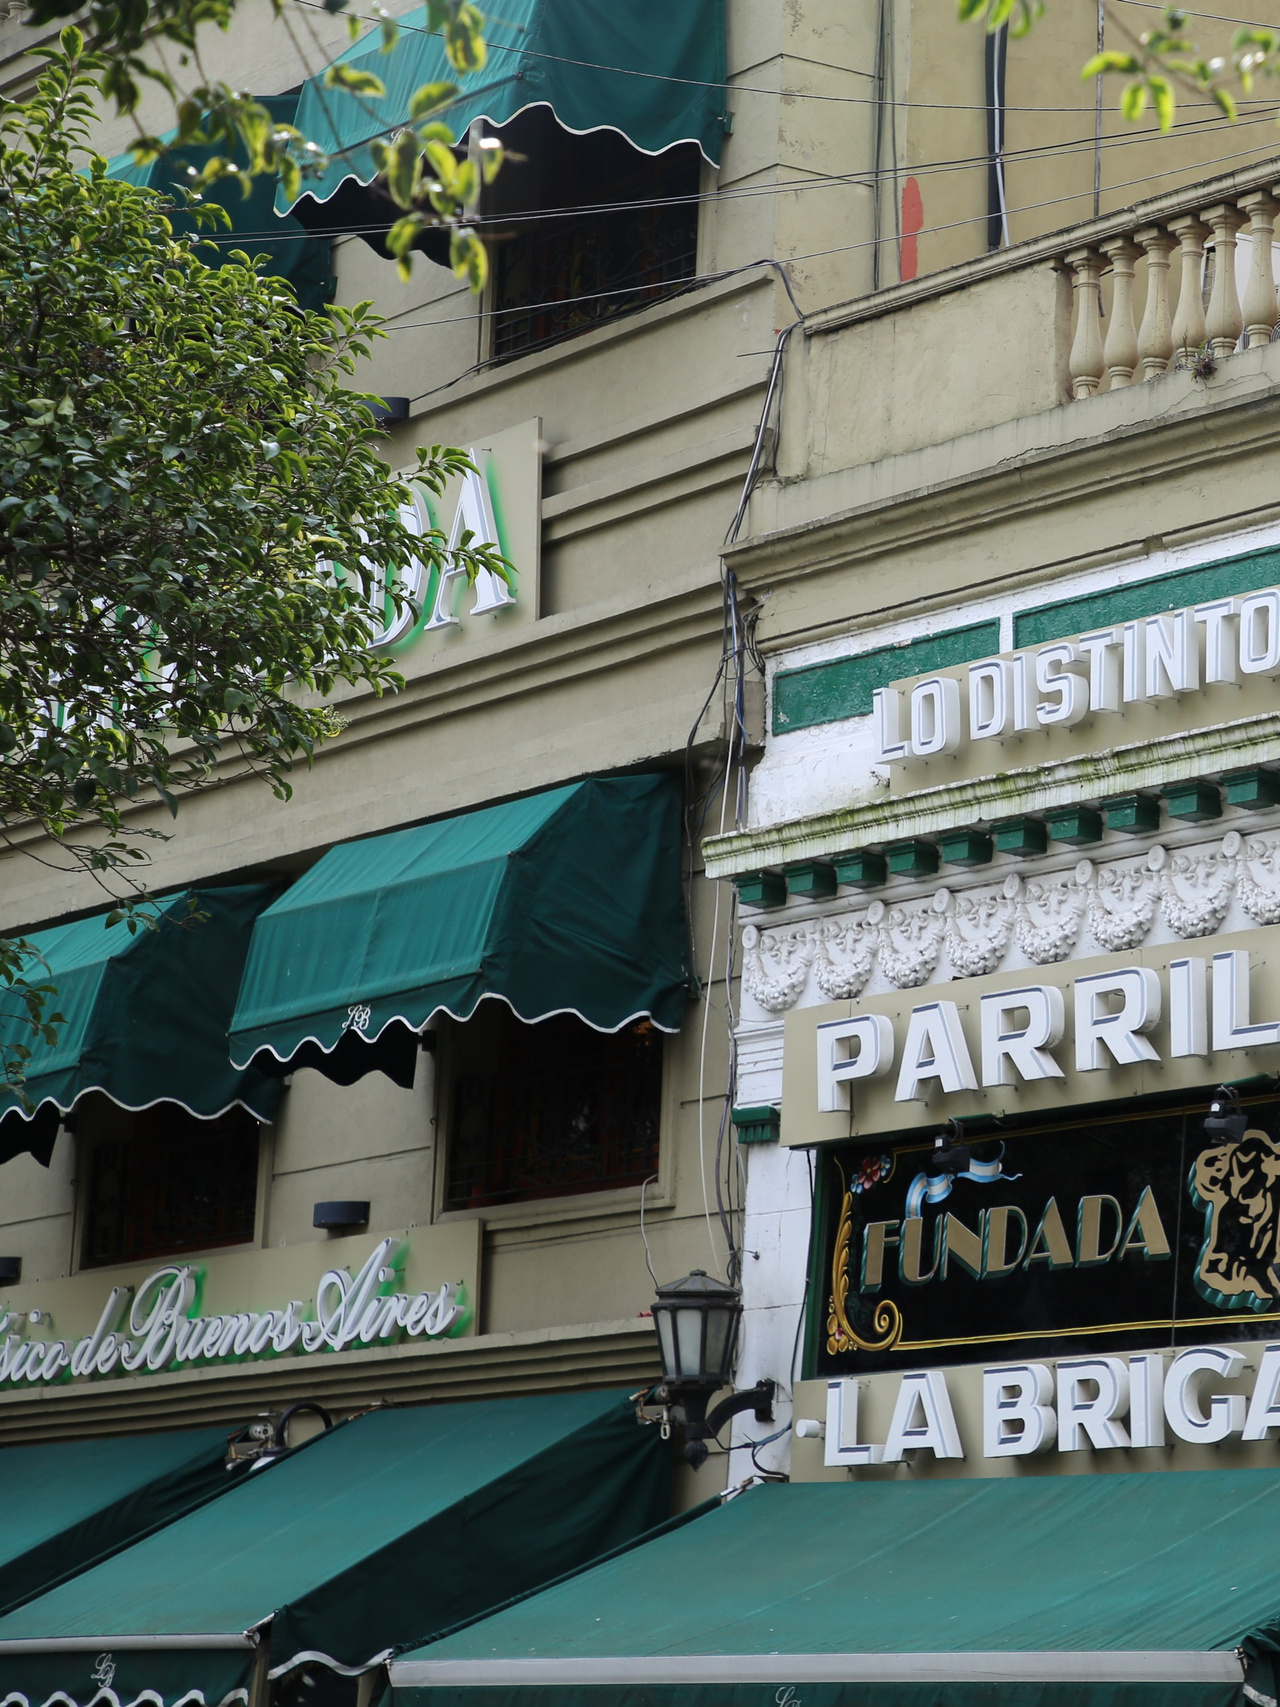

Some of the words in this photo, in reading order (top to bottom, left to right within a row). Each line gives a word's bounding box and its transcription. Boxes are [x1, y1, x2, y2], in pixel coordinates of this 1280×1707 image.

[872, 676, 961, 765] LO
[860, 1185, 1172, 1294] FUNDADA
[71, 1286, 124, 1377] de
[121, 1265, 303, 1371] Buenos
[302, 1237, 465, 1352] Aires
[824, 1370, 963, 1467] LA
